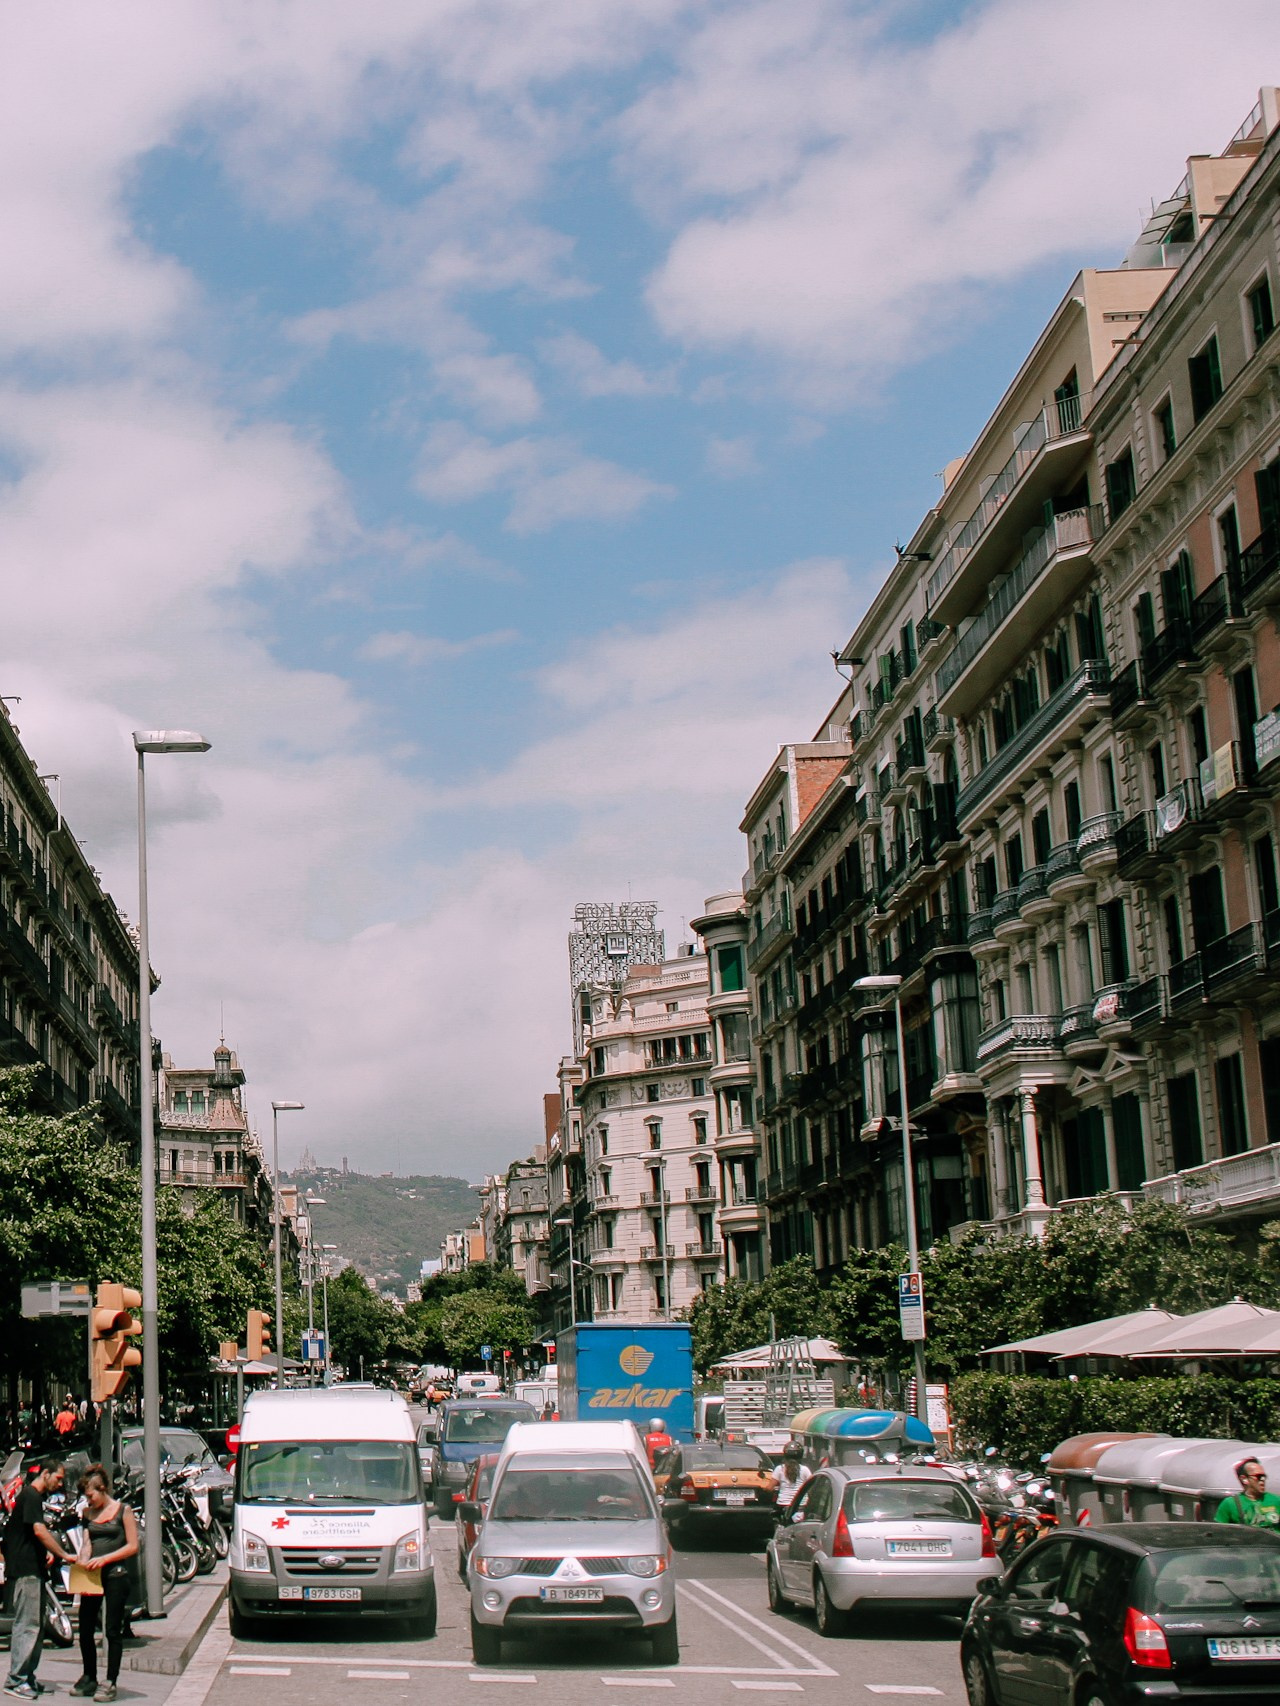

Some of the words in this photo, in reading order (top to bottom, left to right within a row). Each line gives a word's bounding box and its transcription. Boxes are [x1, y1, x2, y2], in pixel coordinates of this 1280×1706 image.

[588, 1383, 683, 1408] azkar
[896, 1542, 923, 1553] 7041
[310, 1589, 337, 1599] 9783
[339, 1589, 360, 1600] GSH
[550, 1589, 558, 1599] B
[563, 1589, 587, 1599] 1849
[588, 1589, 601, 1599] PK
[1220, 1639, 1261, 1655] 0615
